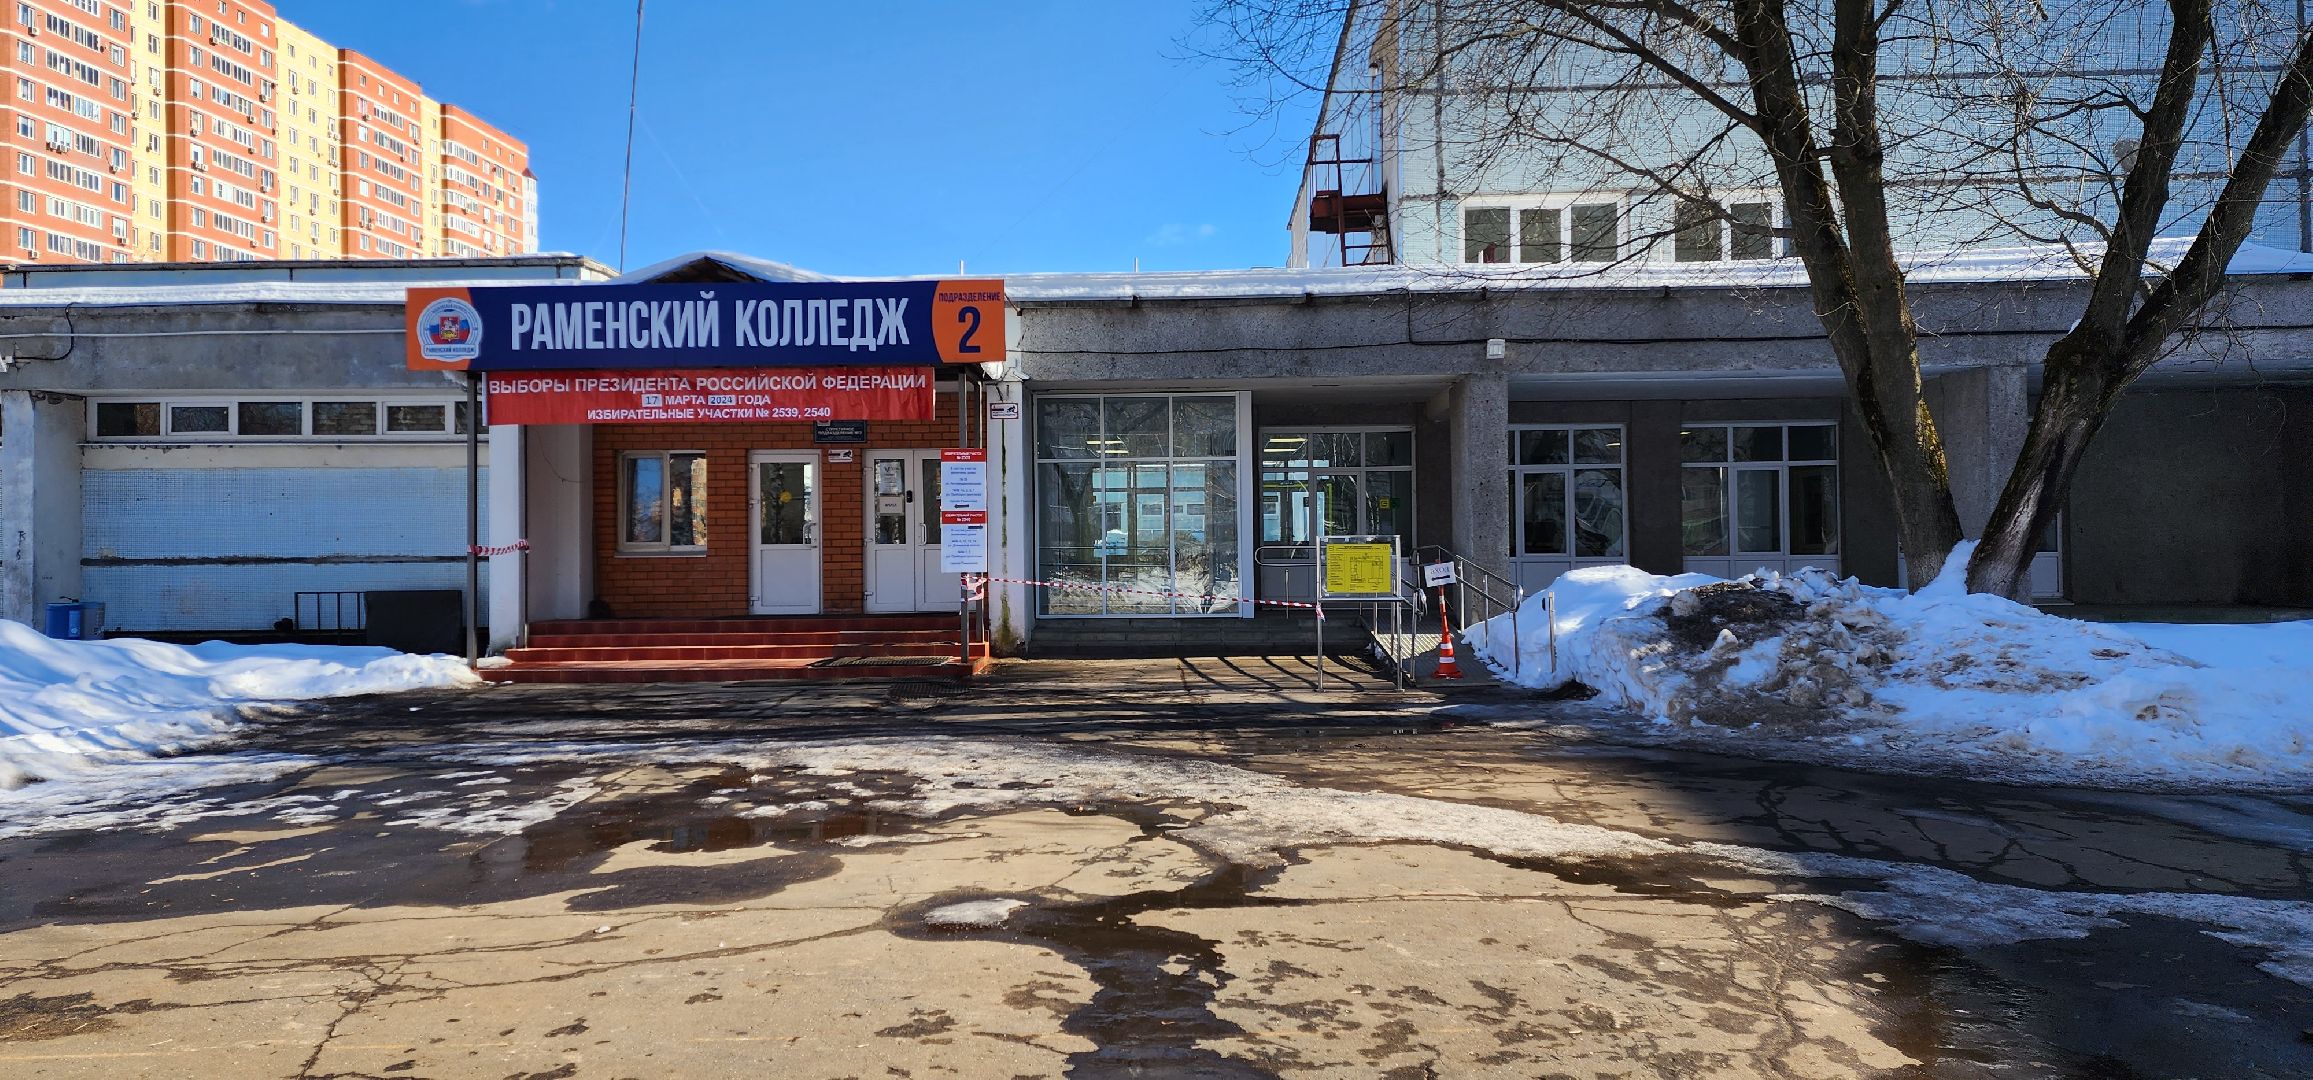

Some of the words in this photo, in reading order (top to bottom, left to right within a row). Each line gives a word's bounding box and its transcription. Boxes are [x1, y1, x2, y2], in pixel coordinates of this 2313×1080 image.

[938, 291, 1001, 303] ПОДРАЗДЕЛЕНИЕ
[511, 290, 720, 350] РАМЕНСКИЙ
[735, 298, 910, 352] КОЛЛЕДЖ
[958, 306, 981, 353] 2
[488, 378, 569, 394] ВЫБОРЫ
[575, 377, 691, 394] ПРЕЗИДЕНТА
[696, 373, 817, 391] РОССИЙСКОЙ
[821, 374, 926, 391] ФЕДЕРАЦИИ
[645, 395, 659, 405] 17
[665, 394, 706, 405] МАРТА
[710, 396, 733, 405] 2024
[738, 394, 771, 406] ГОДА
[587, 408, 694, 420] ИЗБИРАТЕЛЬНЫЕ
[697, 408, 753, 419] УЧАСТКИ
[755, 408, 769, 418] №
[772, 407, 801, 419] 2539,
[803, 407, 831, 417] 2540
